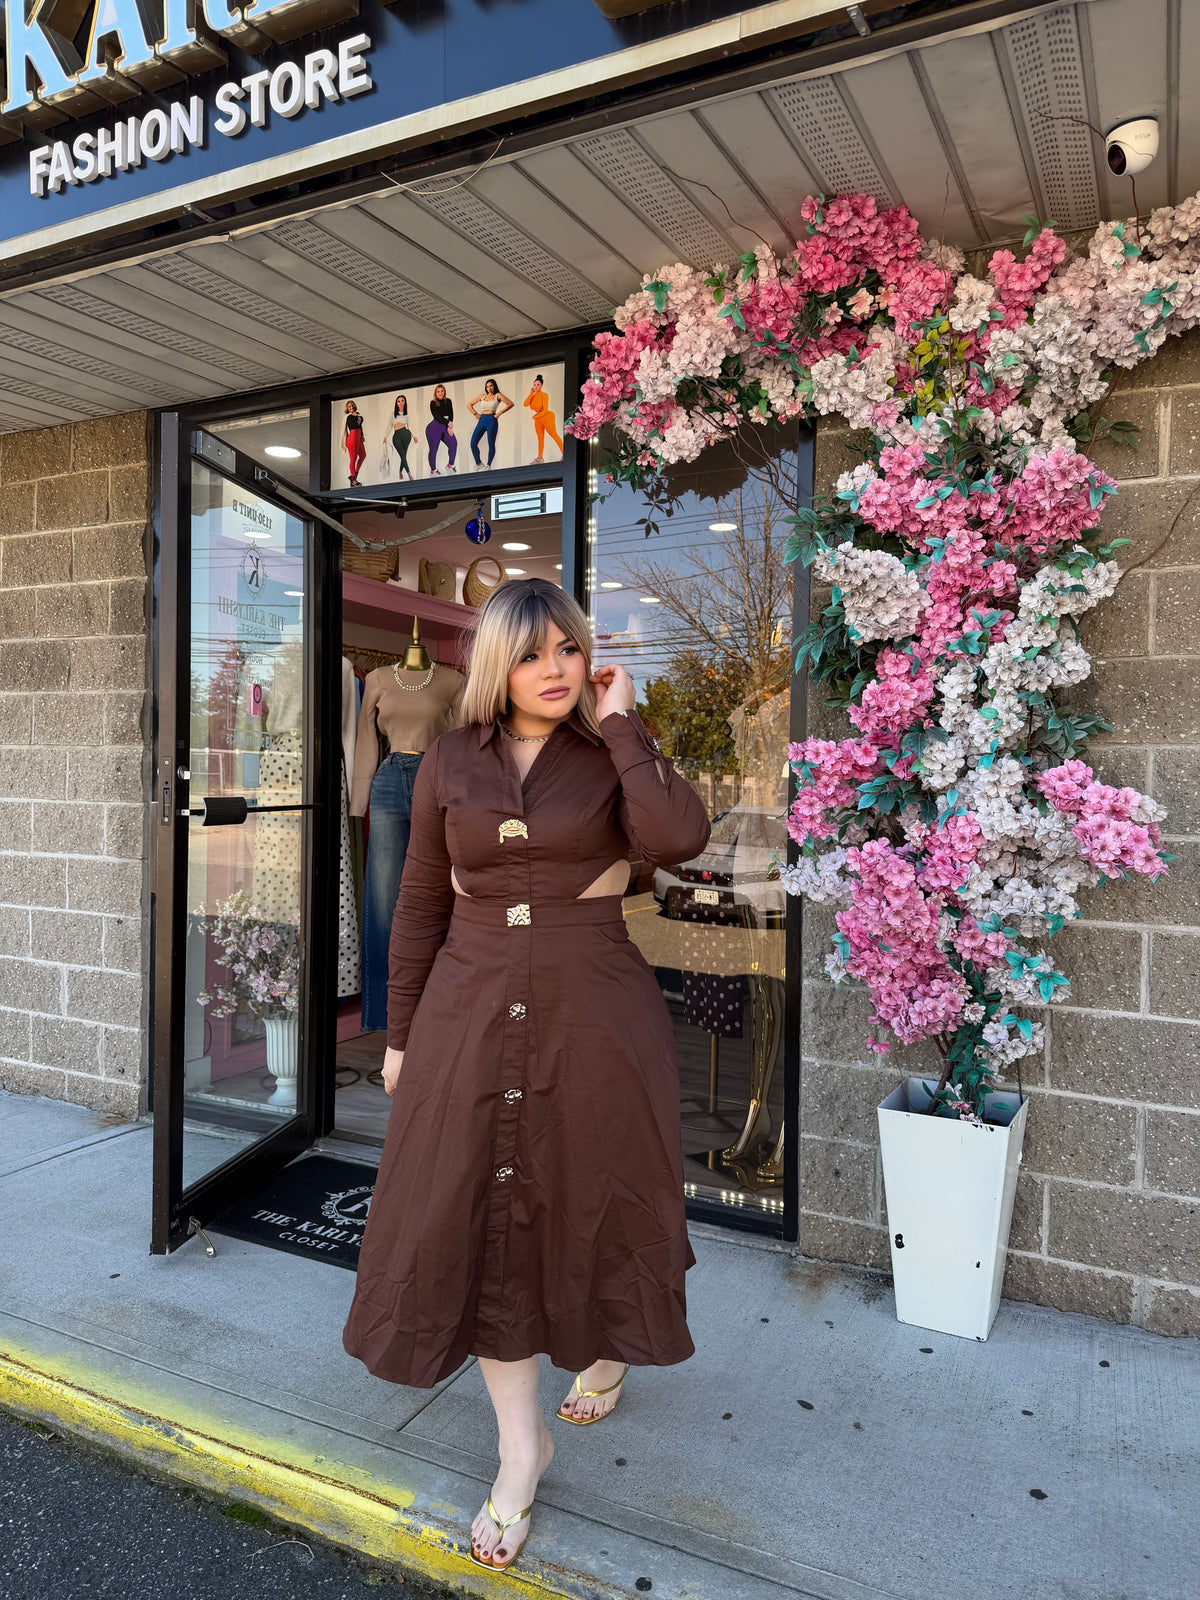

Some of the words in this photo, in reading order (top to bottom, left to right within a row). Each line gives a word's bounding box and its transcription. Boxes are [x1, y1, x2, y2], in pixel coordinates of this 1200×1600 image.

[29, 95, 204, 197] FASHION
[214, 33, 373, 136] STORE
[251, 1210, 298, 1227] THE
[279, 1232, 339, 1250] CLOSET
